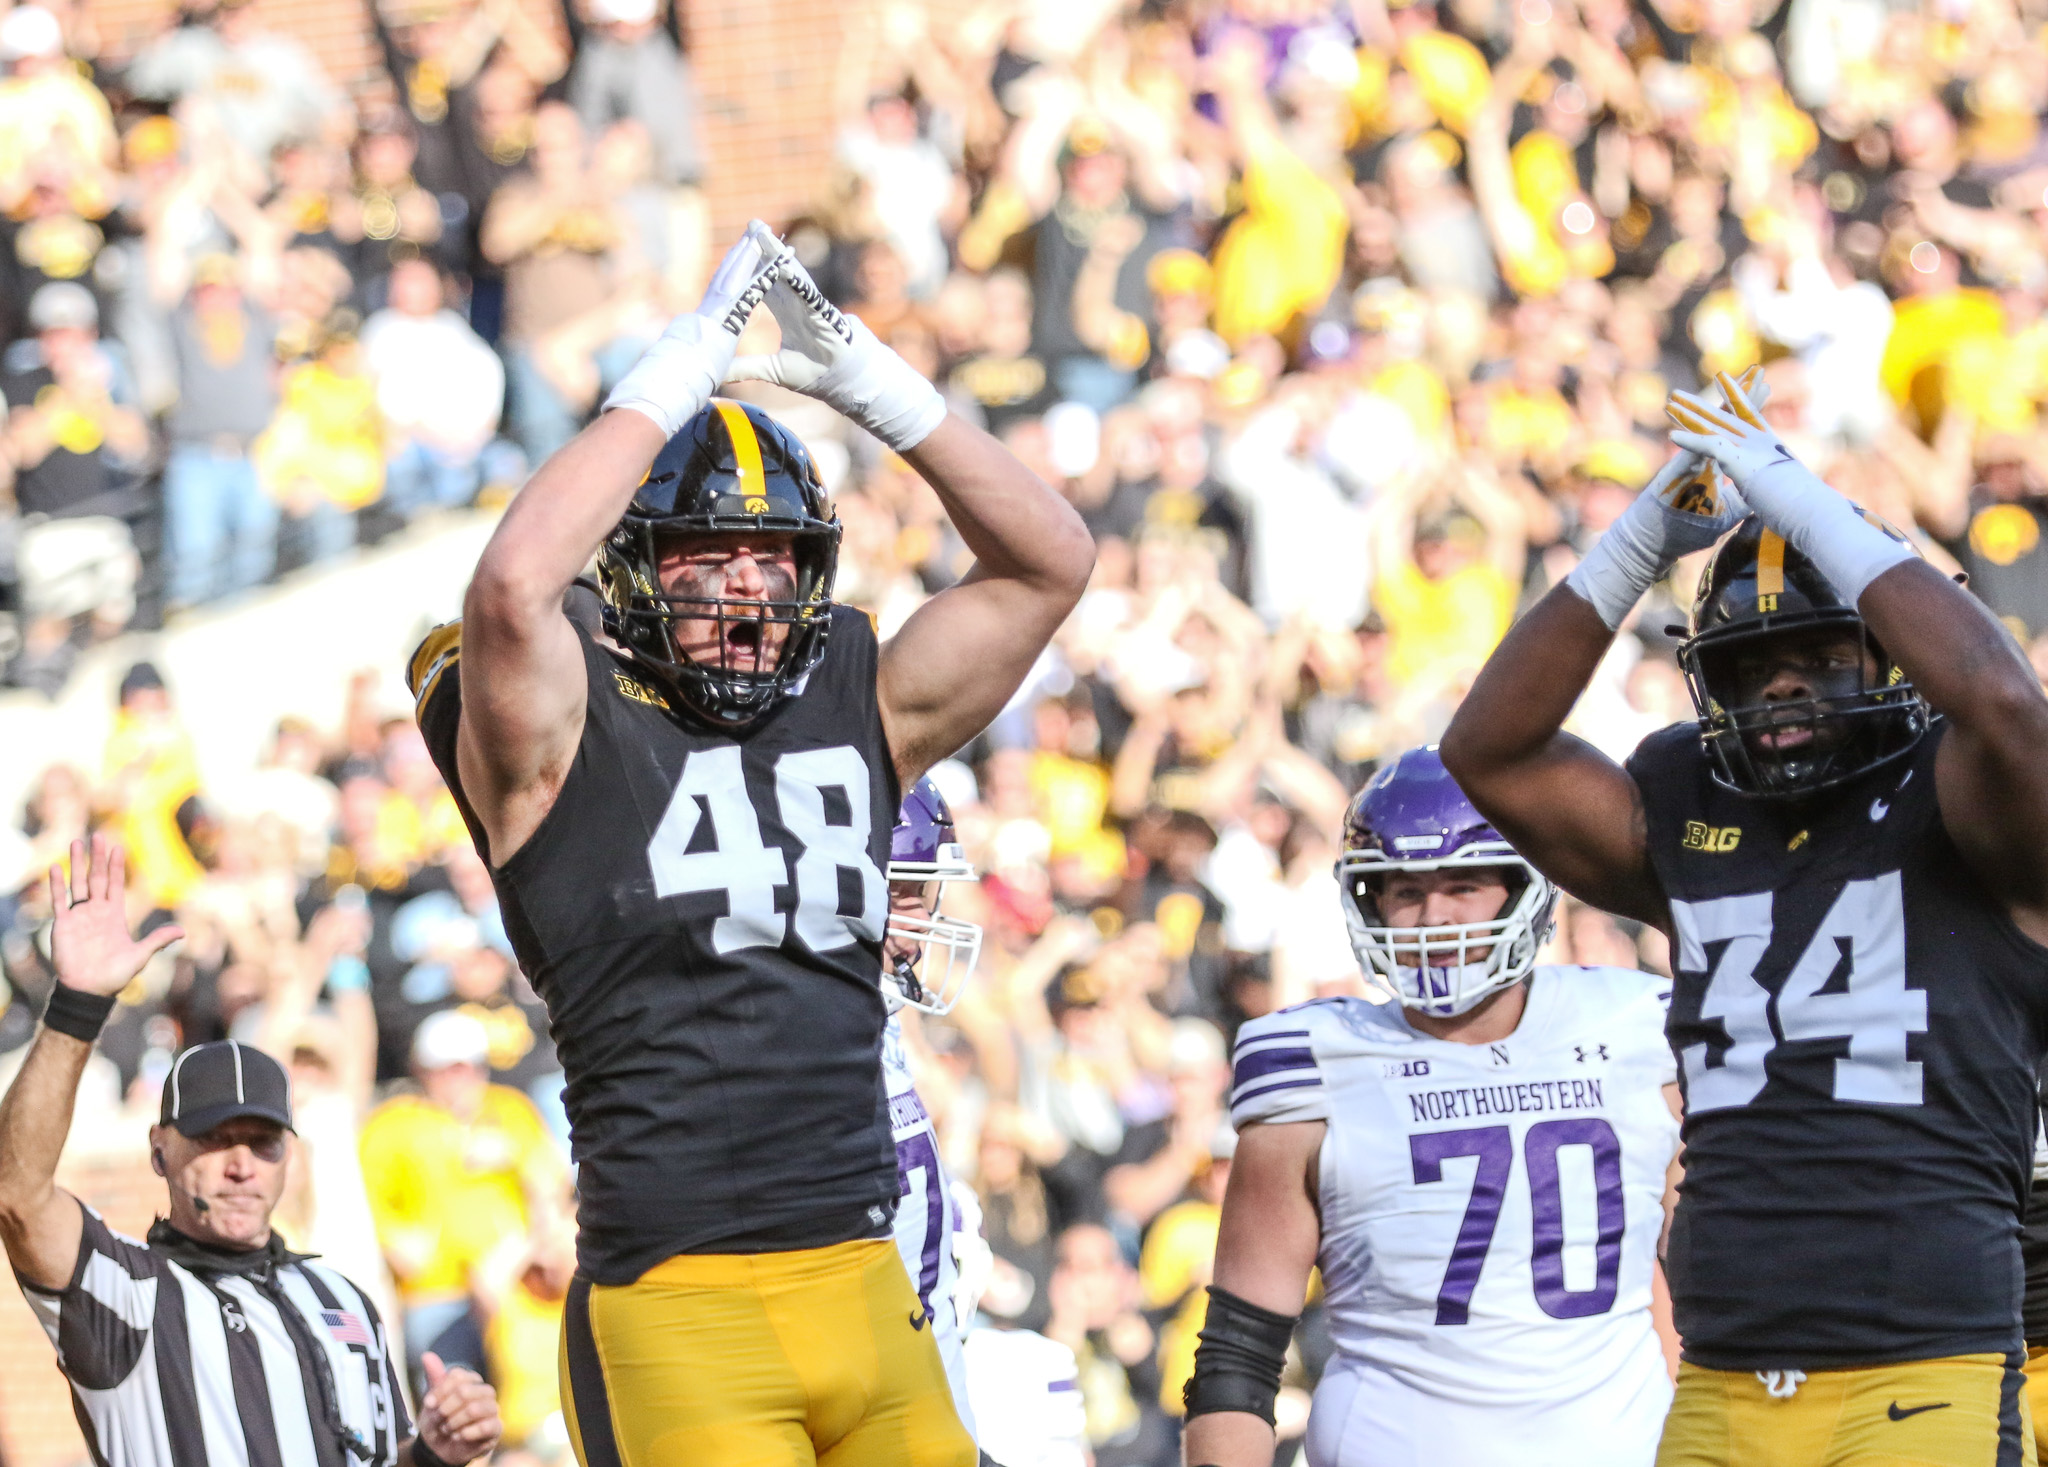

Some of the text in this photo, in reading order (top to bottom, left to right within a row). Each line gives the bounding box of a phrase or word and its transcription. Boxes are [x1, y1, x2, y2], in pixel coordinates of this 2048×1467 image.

[647, 745, 889, 955] 48
[1490, 1044, 1510, 1066] N
[1671, 869, 1928, 1115] 34
[1408, 1079, 1604, 1122] NORTHWESTERN
[1409, 1118, 1625, 1326] 70
